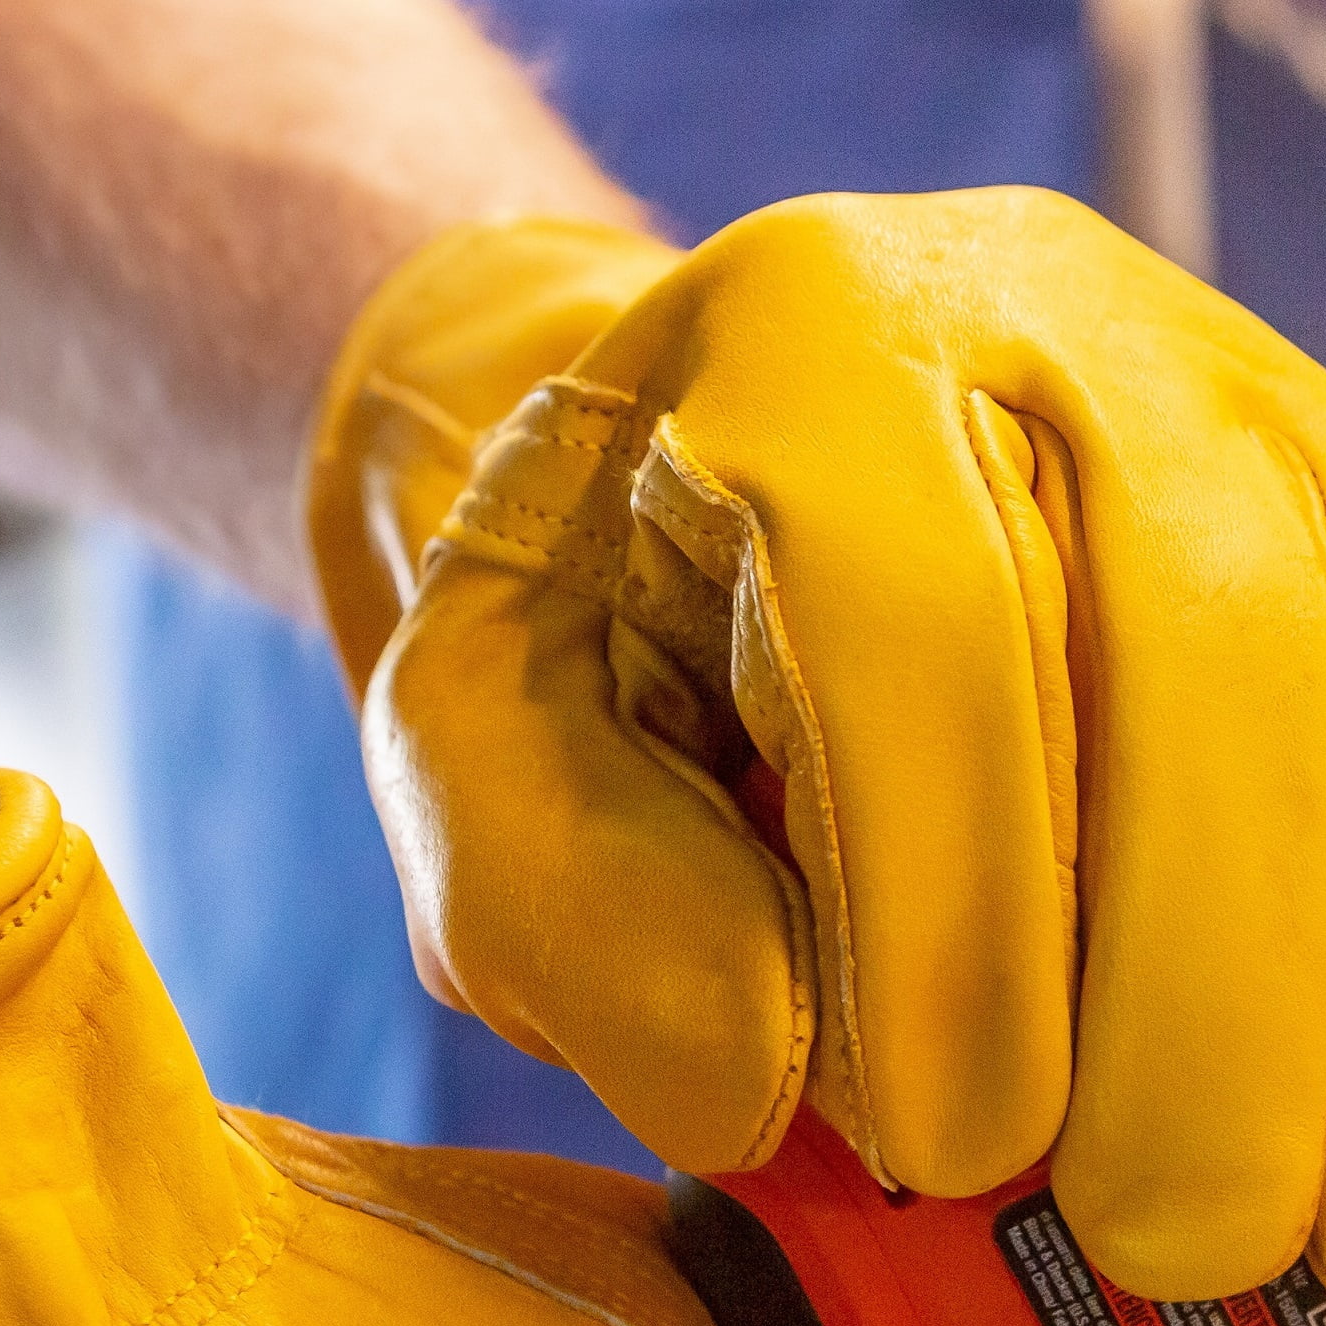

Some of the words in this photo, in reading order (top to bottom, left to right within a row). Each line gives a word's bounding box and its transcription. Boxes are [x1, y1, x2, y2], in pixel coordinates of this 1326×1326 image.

[1006, 1223, 1030, 1260] Made
[1021, 1216, 1048, 1251] Black
[1039, 1249, 1054, 1263] &
[1045, 1259, 1075, 1302] Decker
